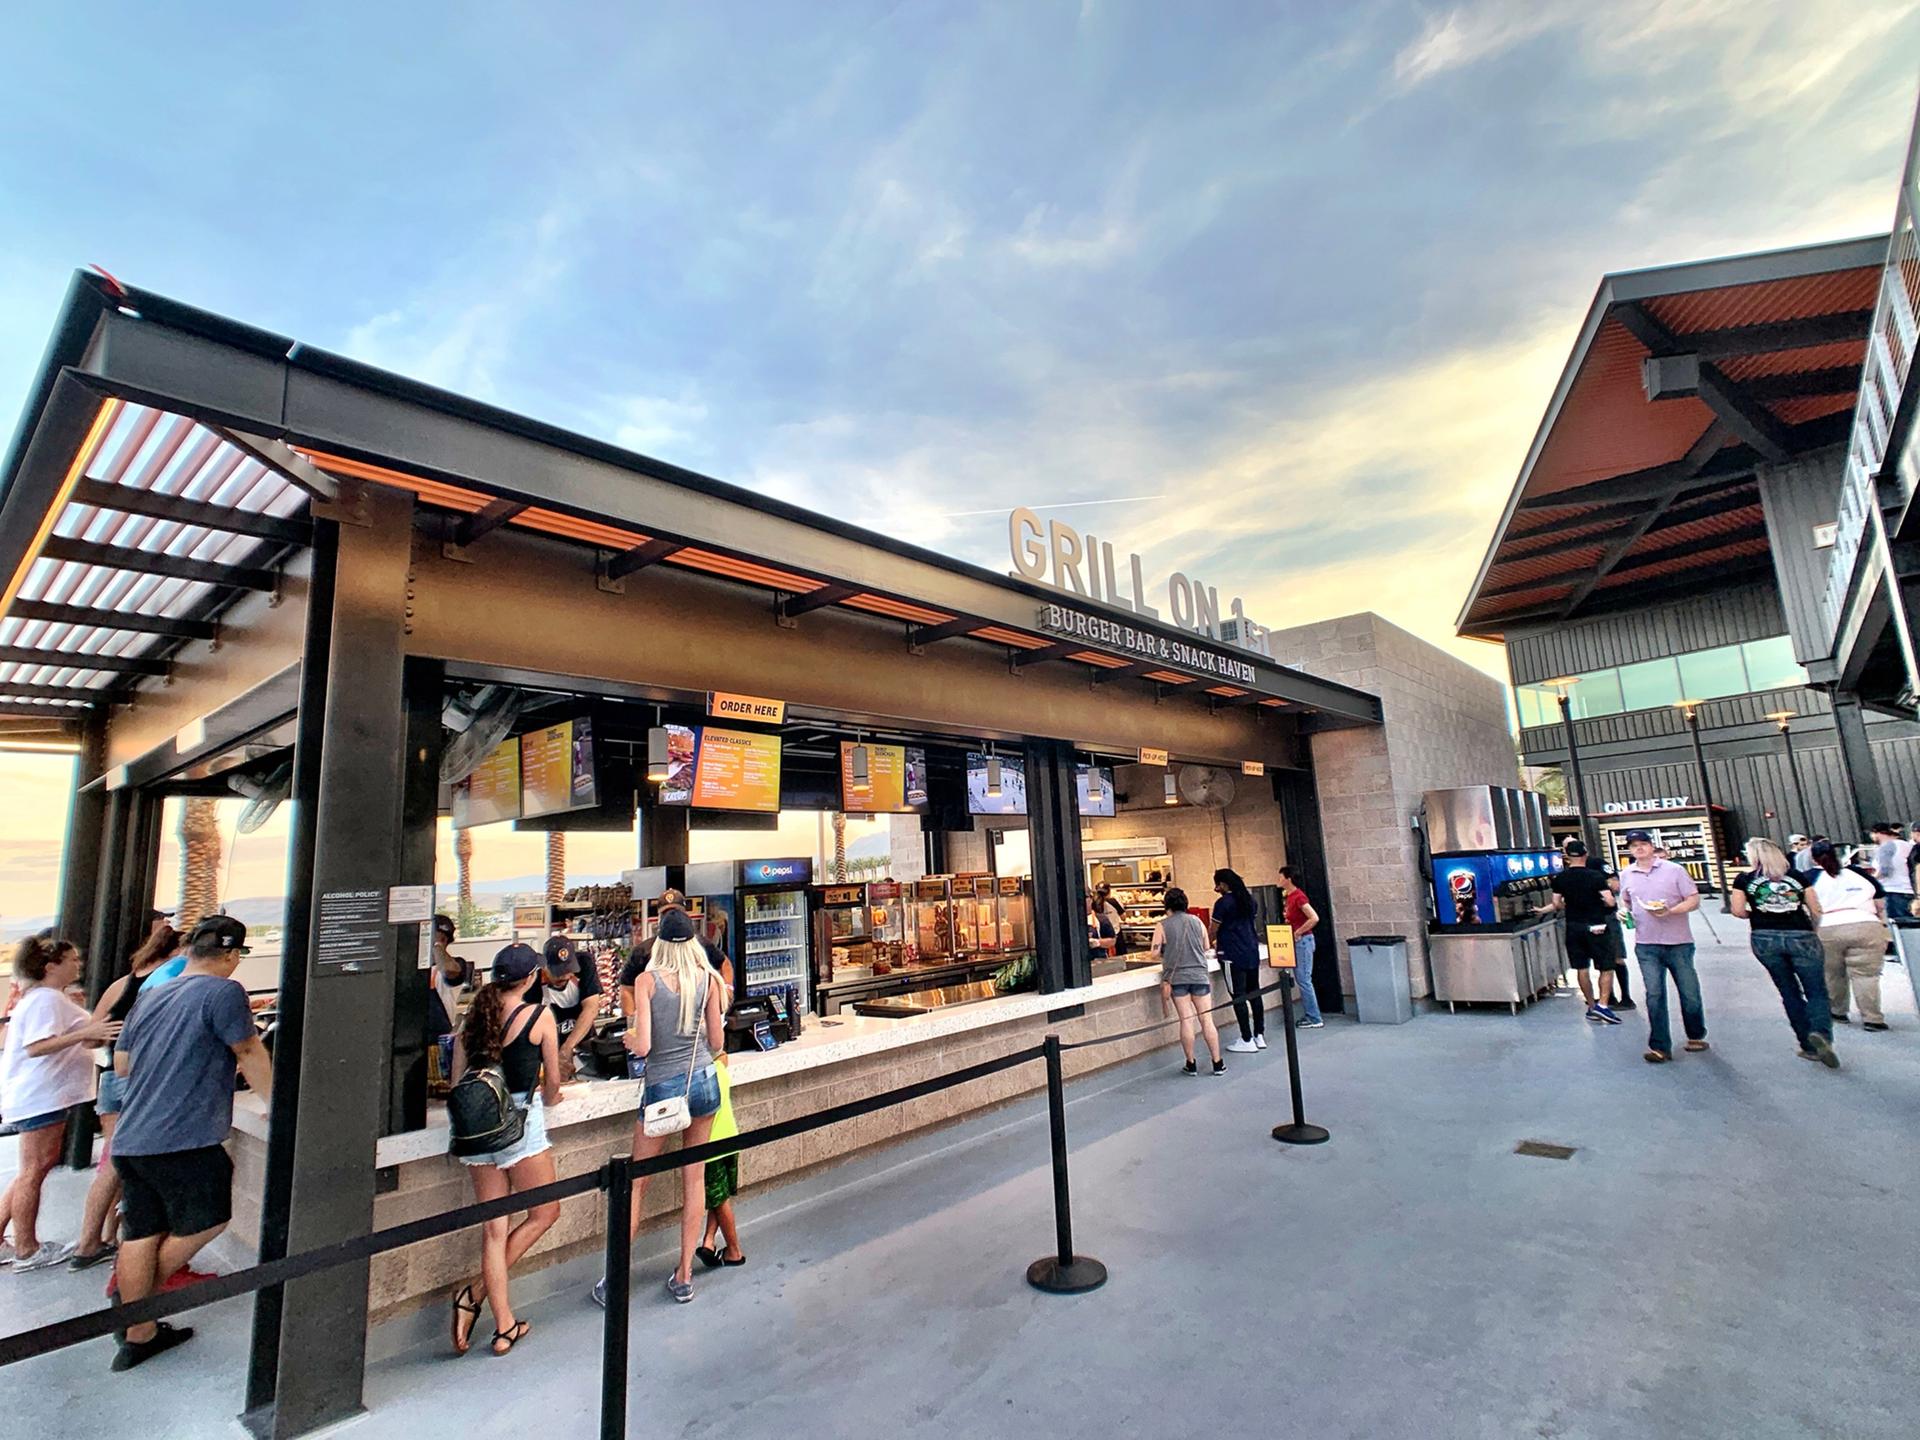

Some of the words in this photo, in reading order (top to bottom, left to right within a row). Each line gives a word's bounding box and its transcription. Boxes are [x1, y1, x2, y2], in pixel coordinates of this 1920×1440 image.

[1009, 507, 1158, 620] GRILL
[1169, 572, 1222, 642] ON
[1049, 604, 1122, 645] BURGER
[1124, 626, 1157, 656] BAR
[1159, 637, 1170, 658] &
[1172, 642, 1217, 674] SNACK
[1217, 656, 1256, 684] HAVEN
[720, 700, 752, 714] ORDER
[754, 705, 778, 717] HERE
[704, 735, 729, 744] ELEVATED
[729, 738, 751, 746] CLASSICS
[1604, 801, 1629, 814] ON
[1628, 799, 1660, 812] THE
[1661, 796, 1689, 809] FLY
[771, 866, 793, 876] pepsi
